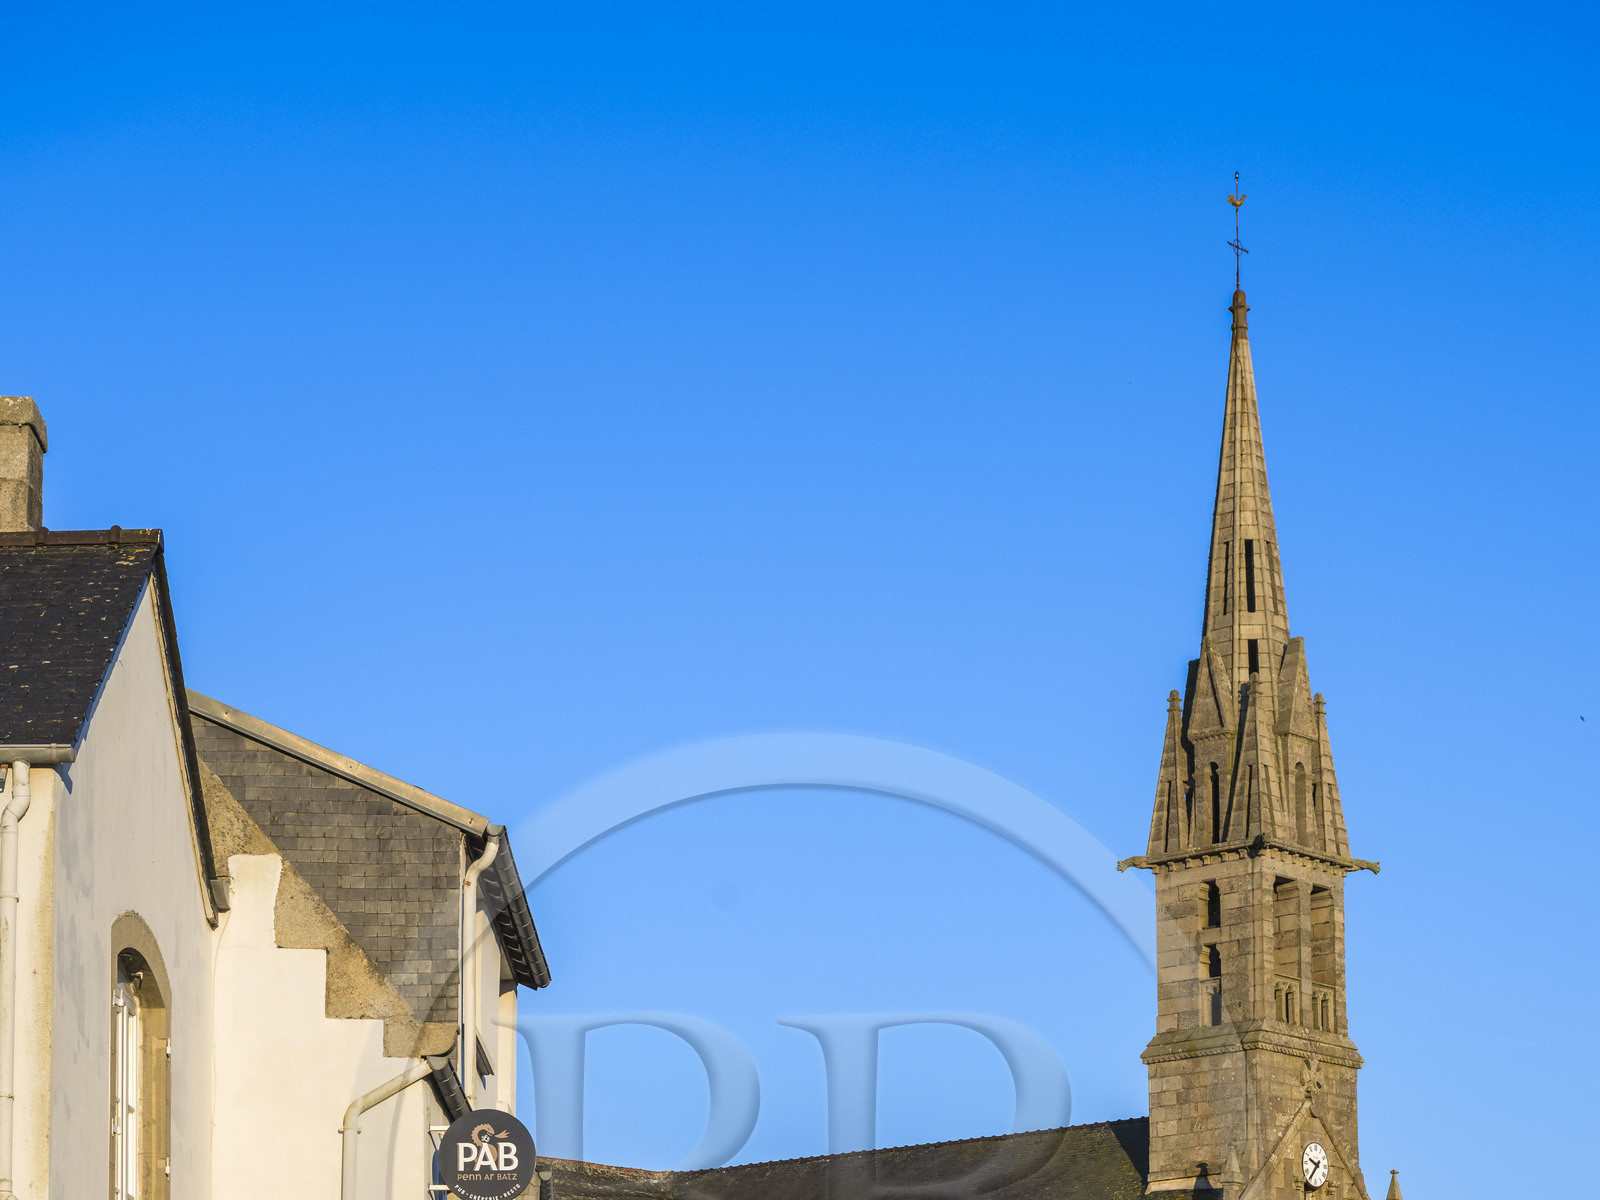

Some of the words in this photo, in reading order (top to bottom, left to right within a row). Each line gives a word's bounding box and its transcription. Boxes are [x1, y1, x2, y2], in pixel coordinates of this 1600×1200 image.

[457, 1142, 519, 1172] PAB
[454, 1184, 466, 1195] PUB
[503, 1183, 521, 1198] RESTO
